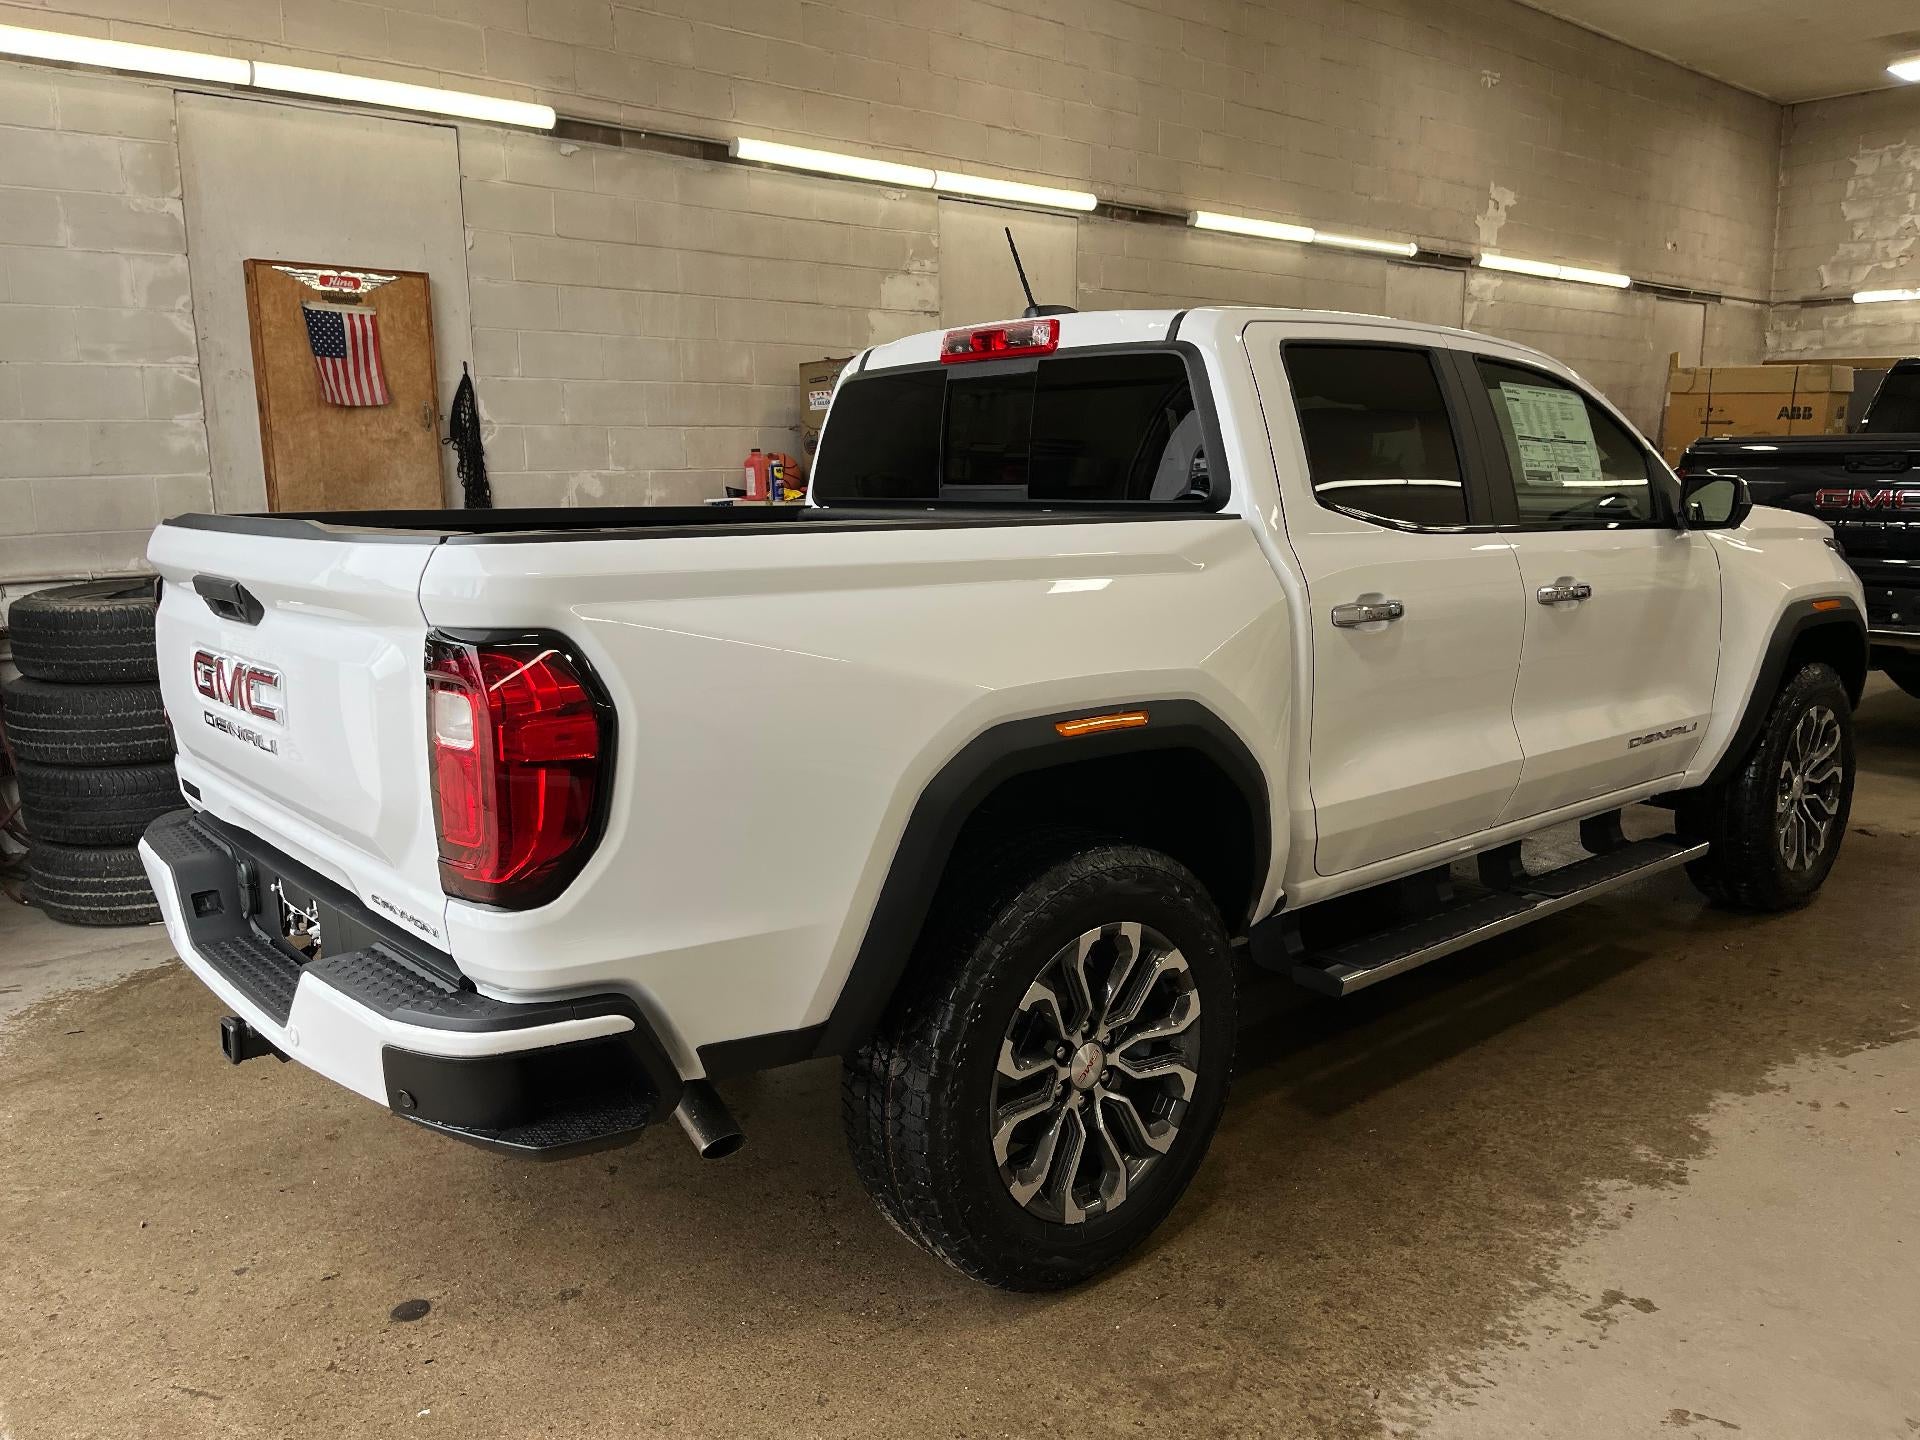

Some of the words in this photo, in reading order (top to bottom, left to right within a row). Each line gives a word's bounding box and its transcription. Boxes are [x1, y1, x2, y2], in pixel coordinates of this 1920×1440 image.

[1777, 406, 1813, 420] ABB
[1815, 488, 1920, 511] GMC
[193, 649, 284, 727] GMC
[204, 710, 279, 755] DENALI
[1628, 721, 1698, 749] DENALI
[371, 894, 440, 939] CANYON
[1079, 1049, 1100, 1083] GMC
